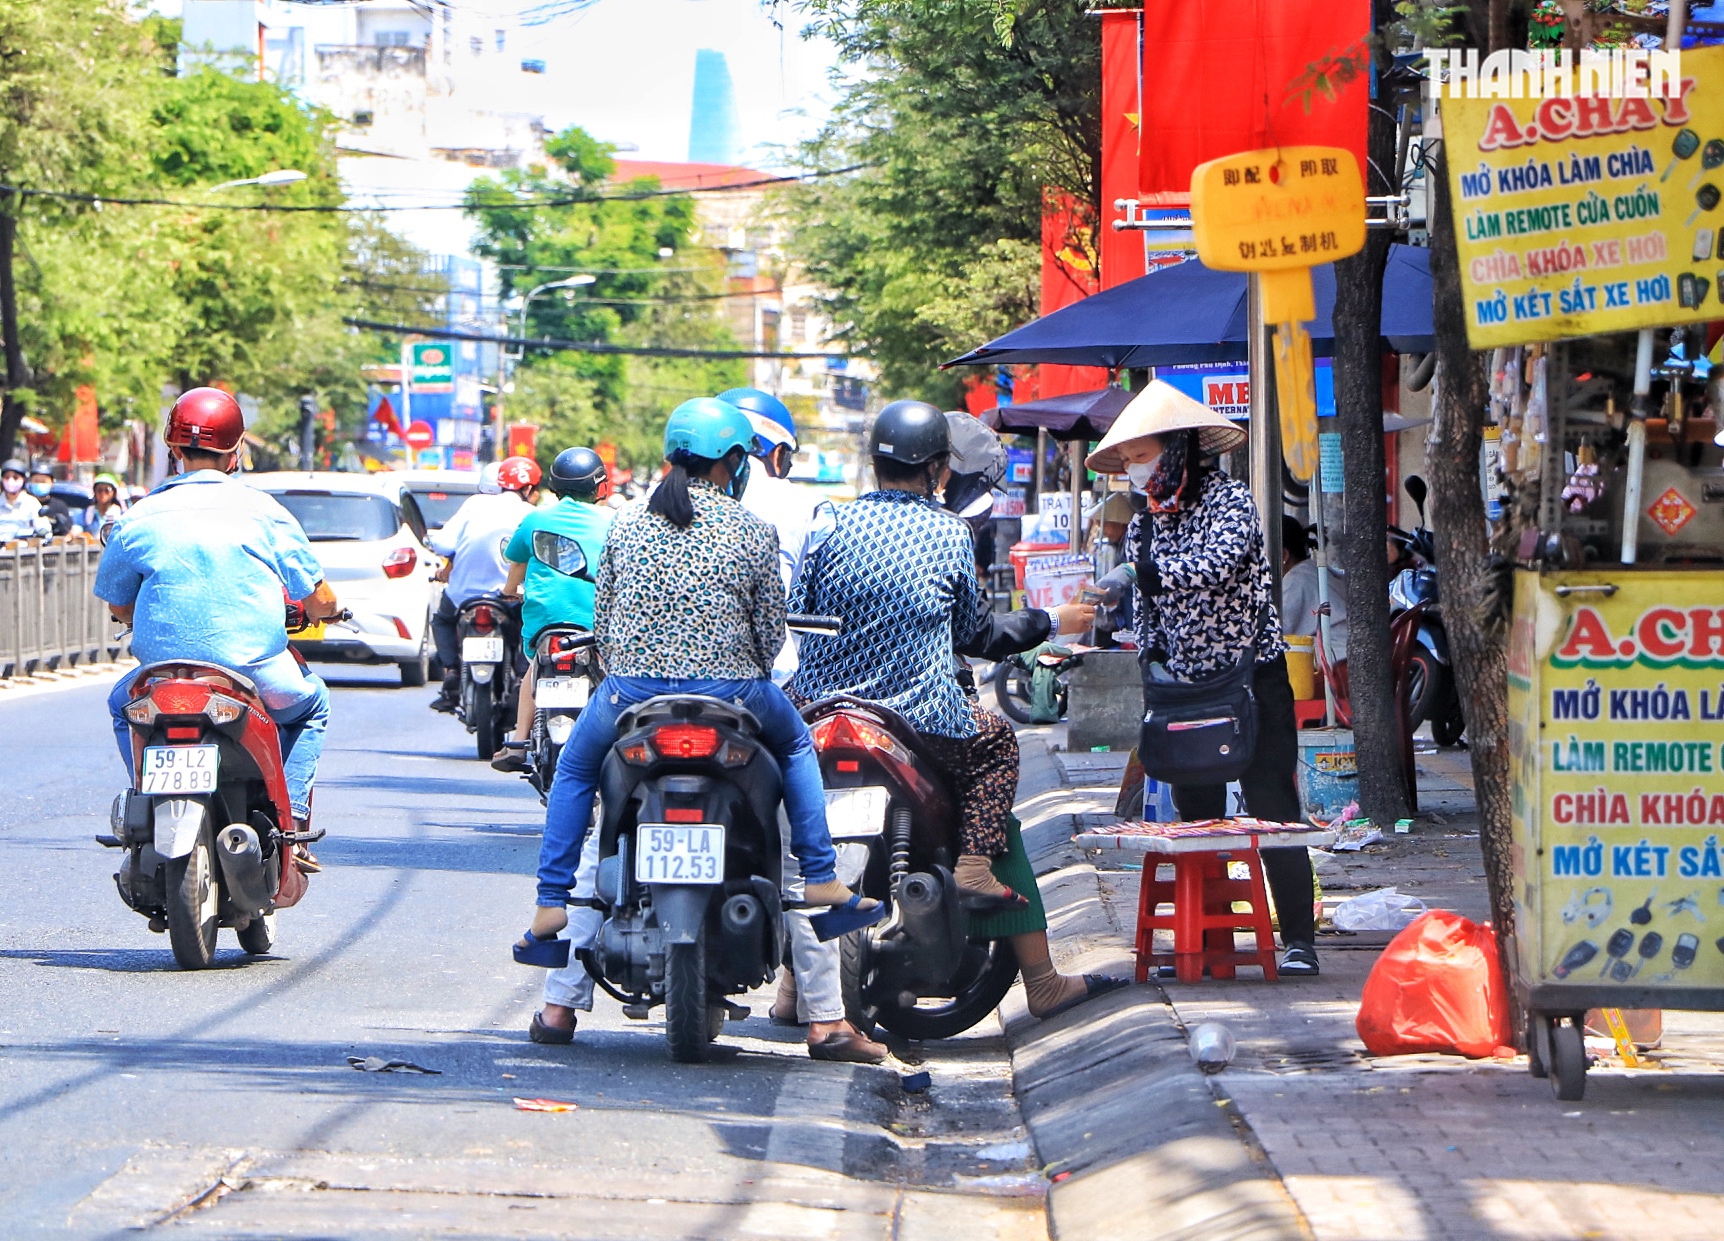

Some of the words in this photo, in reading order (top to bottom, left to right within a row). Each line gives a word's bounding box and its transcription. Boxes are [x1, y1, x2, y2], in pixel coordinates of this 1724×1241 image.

[1461, 163, 1491, 198] MỞ
[1498, 158, 1553, 193] KHÓA
[1558, 153, 1601, 185] LÀM
[1607, 146, 1654, 178] CHÌA
[1466, 210, 1501, 240] LÀM
[1505, 204, 1572, 236] REMOTE
[1576, 191, 1610, 226] CỬA
[1614, 184, 1660, 221] CUỐN
[1471, 249, 1521, 283] CHÌA
[1527, 240, 1587, 276] KHÓA
[1593, 241, 1620, 267] XE
[1628, 232, 1667, 264] HƠI
[1476, 289, 1507, 325] MỞ
[1514, 288, 1552, 320] KÉT
[1560, 277, 1597, 314] SẮT
[1604, 283, 1630, 308] XE
[1636, 274, 1671, 304] HƠI
[1553, 679, 1601, 720] MỞ
[1610, 684, 1690, 720] KHÓA
[1553, 735, 1605, 772] LÀM
[1613, 742, 1712, 772] REMOTE
[147, 771, 212, 792] 778.89
[1553, 788, 1630, 824] CHÌA
[1641, 788, 1724, 825] KHÓA
[650, 829, 711, 853] 59-LA
[1553, 836, 1603, 876] MỞ
[1613, 840, 1669, 876] KÉT
[1679, 836, 1724, 877] SẮ
[646, 855, 717, 879] 112.53
